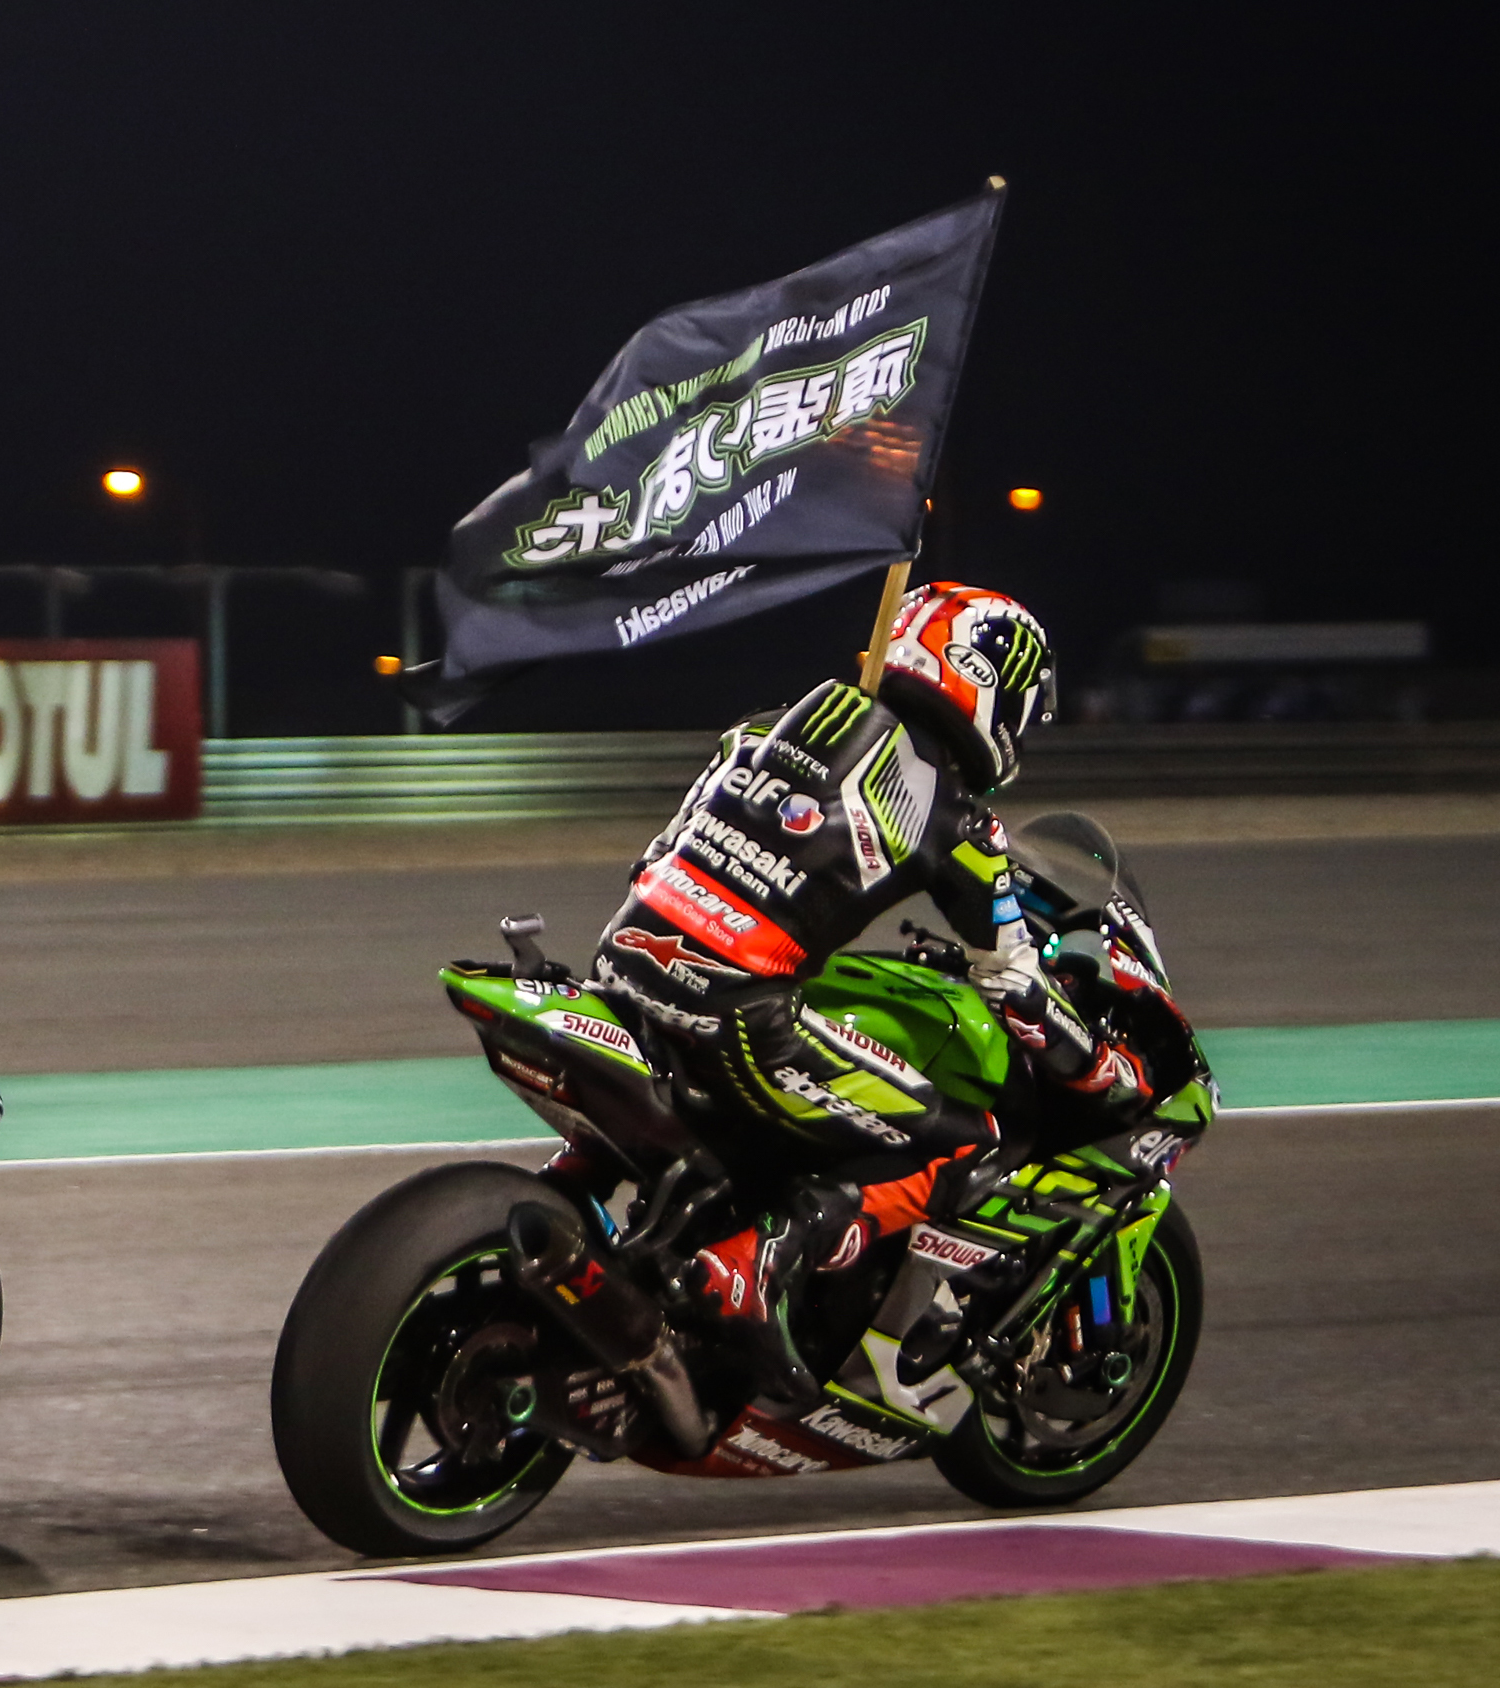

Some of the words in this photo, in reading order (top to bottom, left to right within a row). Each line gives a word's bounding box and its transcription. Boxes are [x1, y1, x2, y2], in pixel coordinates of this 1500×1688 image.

[720, 765, 790, 805] elf
[694, 810, 808, 898] awasaki
[850, 807, 881, 871] SHOWA
[725, 856, 770, 899] Team
[706, 919, 735, 946] Store
[562, 1012, 632, 1051] SHOWA
[825, 1018, 907, 1073] SHOWA
[911, 1231, 988, 1267] SHOWA
